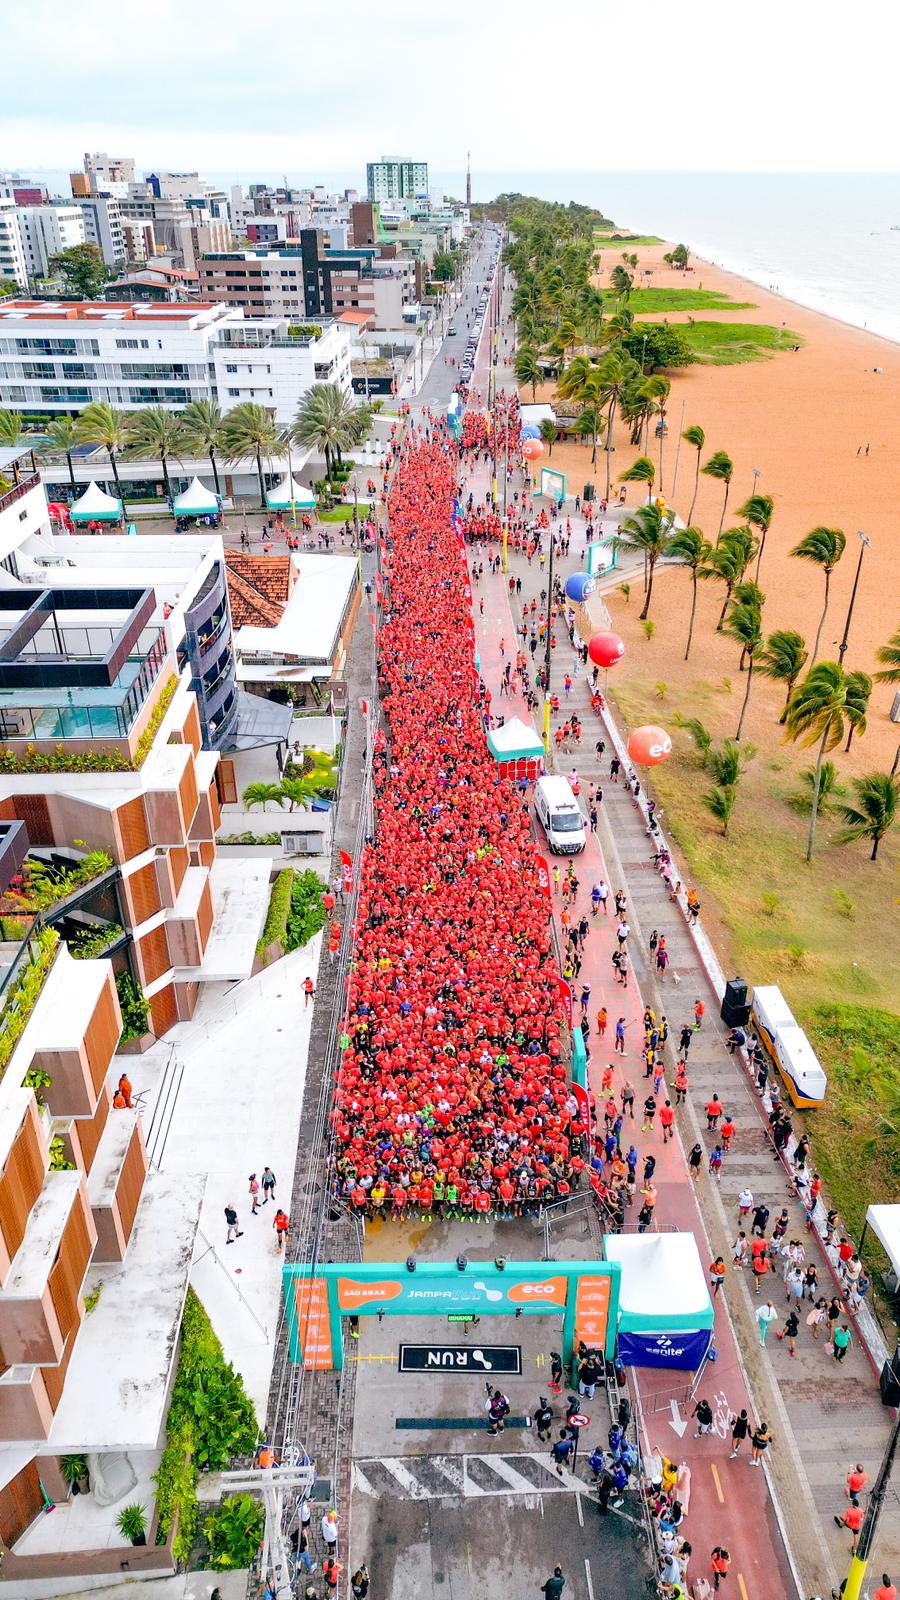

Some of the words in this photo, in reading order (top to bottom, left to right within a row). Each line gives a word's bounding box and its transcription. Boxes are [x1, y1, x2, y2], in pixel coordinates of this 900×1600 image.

[343, 864, 352, 883] eco
[538, 868, 547, 887] eco
[407, 1290, 452, 1298] JAMPA
[522, 1285, 555, 1294] eco
[427, 1351, 468, 1365] RUN
